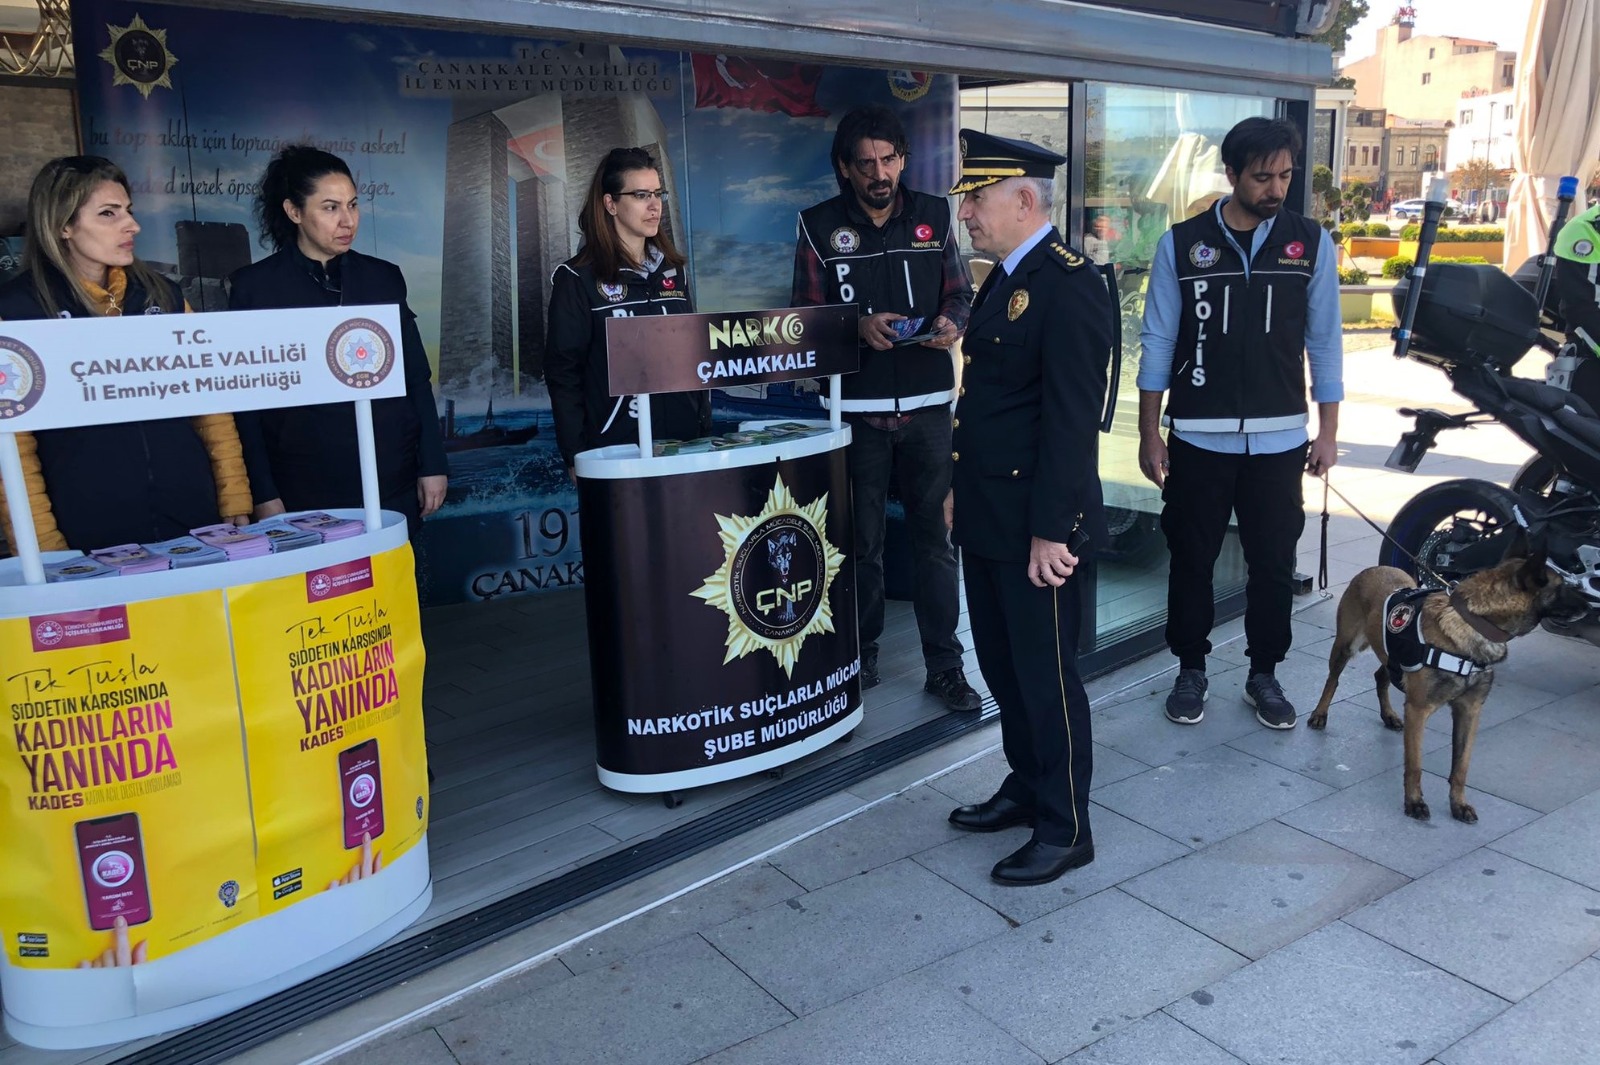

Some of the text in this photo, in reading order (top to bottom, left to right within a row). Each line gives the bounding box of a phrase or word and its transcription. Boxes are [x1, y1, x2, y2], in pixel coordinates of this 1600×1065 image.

[127, 59, 158, 71] ÇNP
[418, 61, 658, 76] ÇANAKKALE VALİLİĞİ
[518, 48, 560, 61] T.C.
[405, 75, 673, 92] İL EMNİYET MÜDÜRLÜĞÜ
[89, 116, 109, 145] bu
[115, 118, 198, 153] topaklar
[203, 129, 227, 153] için
[361, 128, 407, 155] asker!
[181, 168, 224, 195] inerek
[172, 329, 213, 346] T.C.
[1191, 280, 1212, 387] POLİS
[70, 343, 308, 382] ÇANAKKALE VALİLİĞİ
[697, 351, 817, 384] ÇANAKKALE
[82, 371, 302, 402] İl Emniyet Müdürlüğü
[756, 579, 812, 616] ÇNP
[286, 616, 332, 650] Tek
[7, 653, 159, 702] Tek Tuşla
[291, 639, 395, 697] KADINLARIN
[12, 681, 169, 721] ŞİDDETİN KARŞISINDA
[296, 668, 399, 734] YANINDA
[627, 705, 734, 736] NARKOTİK
[739, 680, 825, 719] SUÇLARLA
[14, 699, 174, 753] KADINLARIN
[300, 726, 344, 752] KADES
[704, 691, 849, 760] ŞUBE MÜDÜRLÜĞÜ
[21, 733, 178, 793] YANINDA
[28, 792, 84, 811] KADES
